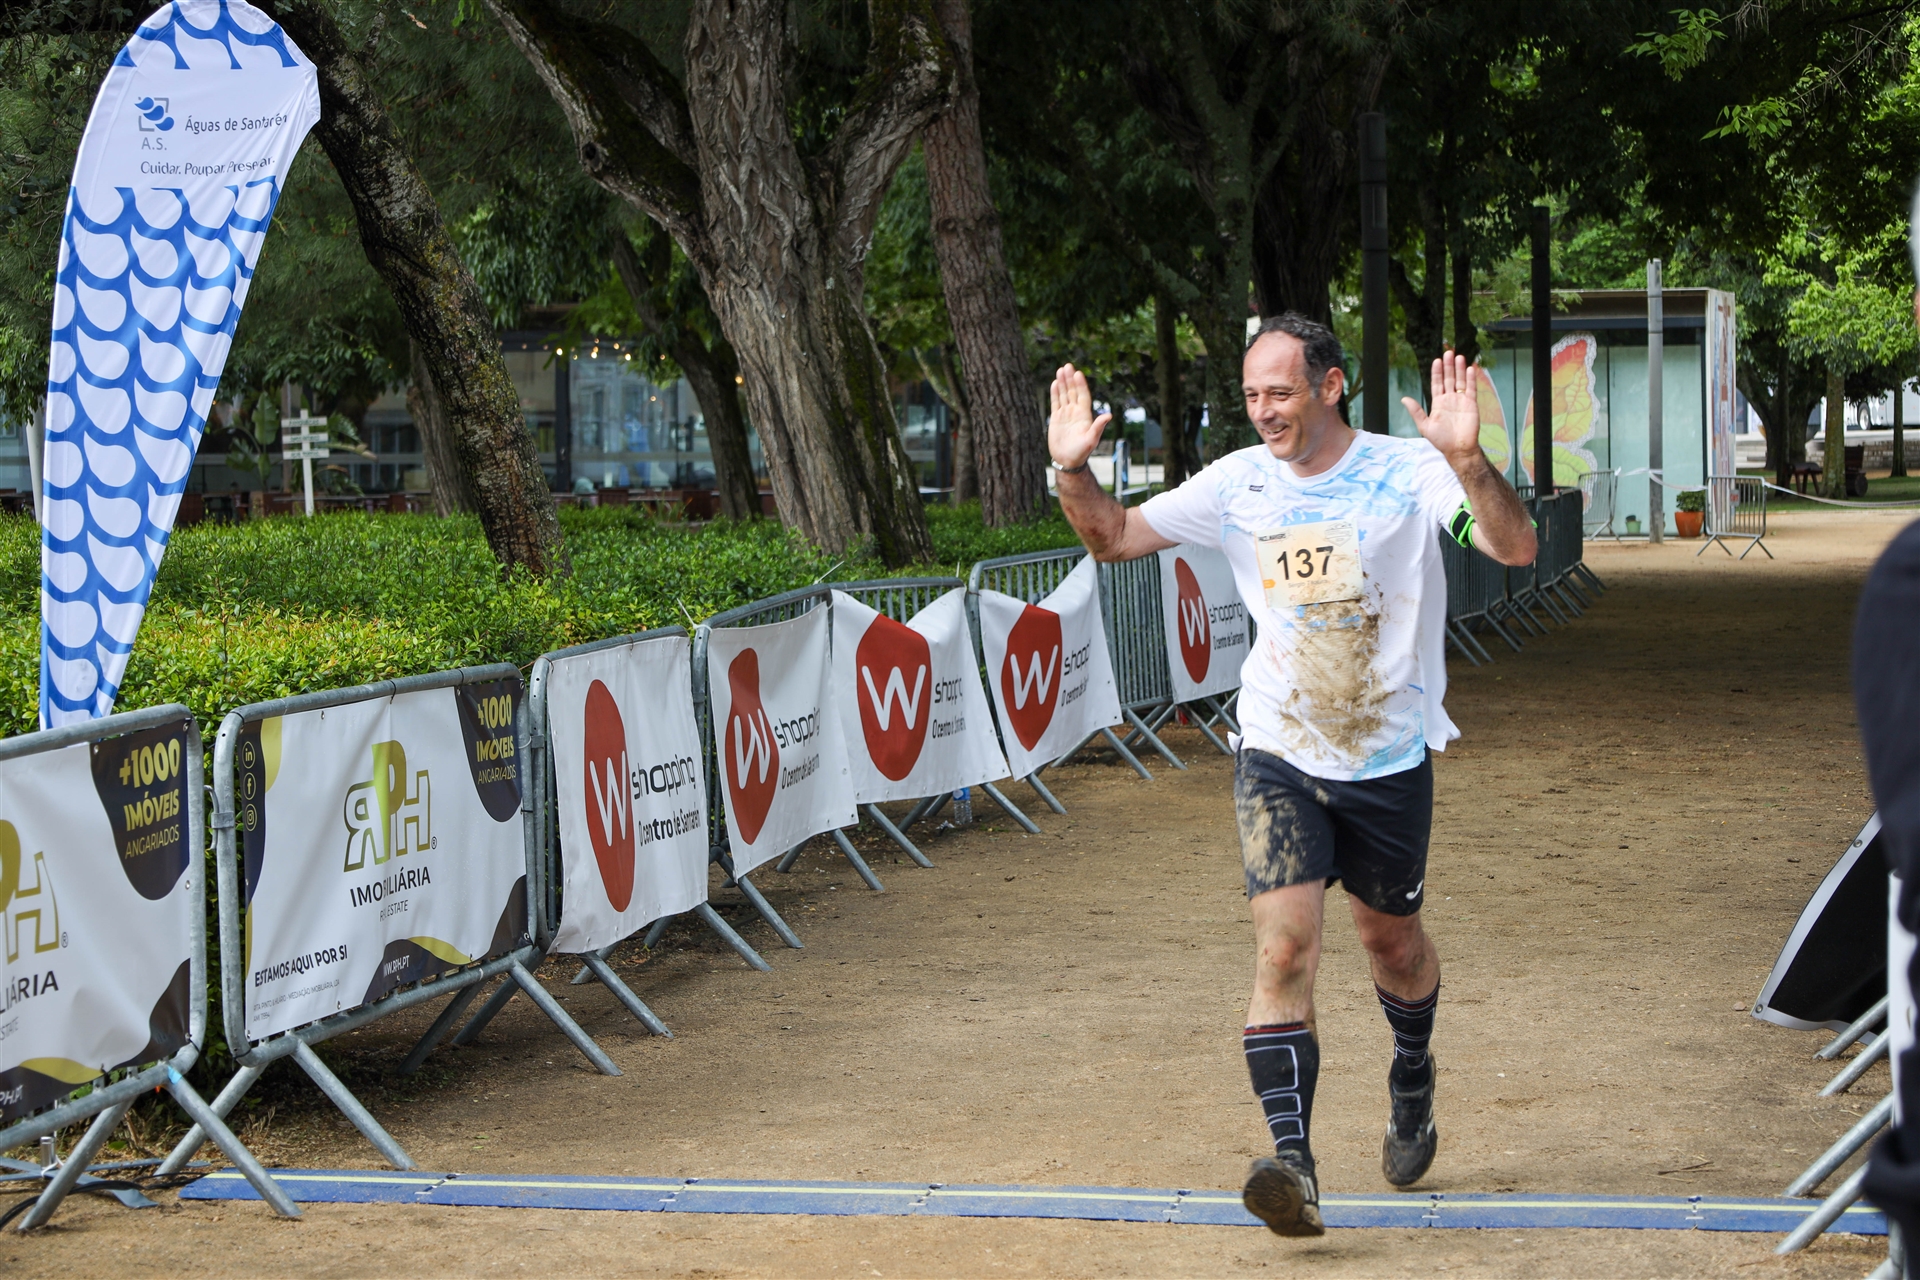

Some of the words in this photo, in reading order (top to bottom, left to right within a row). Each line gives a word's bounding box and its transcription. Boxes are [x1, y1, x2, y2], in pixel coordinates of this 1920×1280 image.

[185, 115, 220, 134] Águas
[225, 117, 238, 131] de
[141, 137, 167, 150] A.S.
[140, 161, 181, 175] Cuidar.
[1277, 545, 1334, 580] 137
[1209, 601, 1243, 625] shopping
[1010, 644, 1059, 711] W
[478, 693, 512, 729] +1000
[861, 664, 927, 732] W
[119, 738, 180, 788] +1000
[733, 708, 771, 790] W
[632, 754, 696, 800] shopping
[123, 788, 180, 832] IMÓVEIS
[125, 824, 180, 859] ANGARIADOS
[643, 818, 674, 845] centro
[387, 899, 409, 917] ESTATE
[255, 960, 290, 987] ESTAMOS
[290, 954, 314, 975] AQUI
[315, 947, 338, 966] POR
[339, 944, 348, 960] SI
